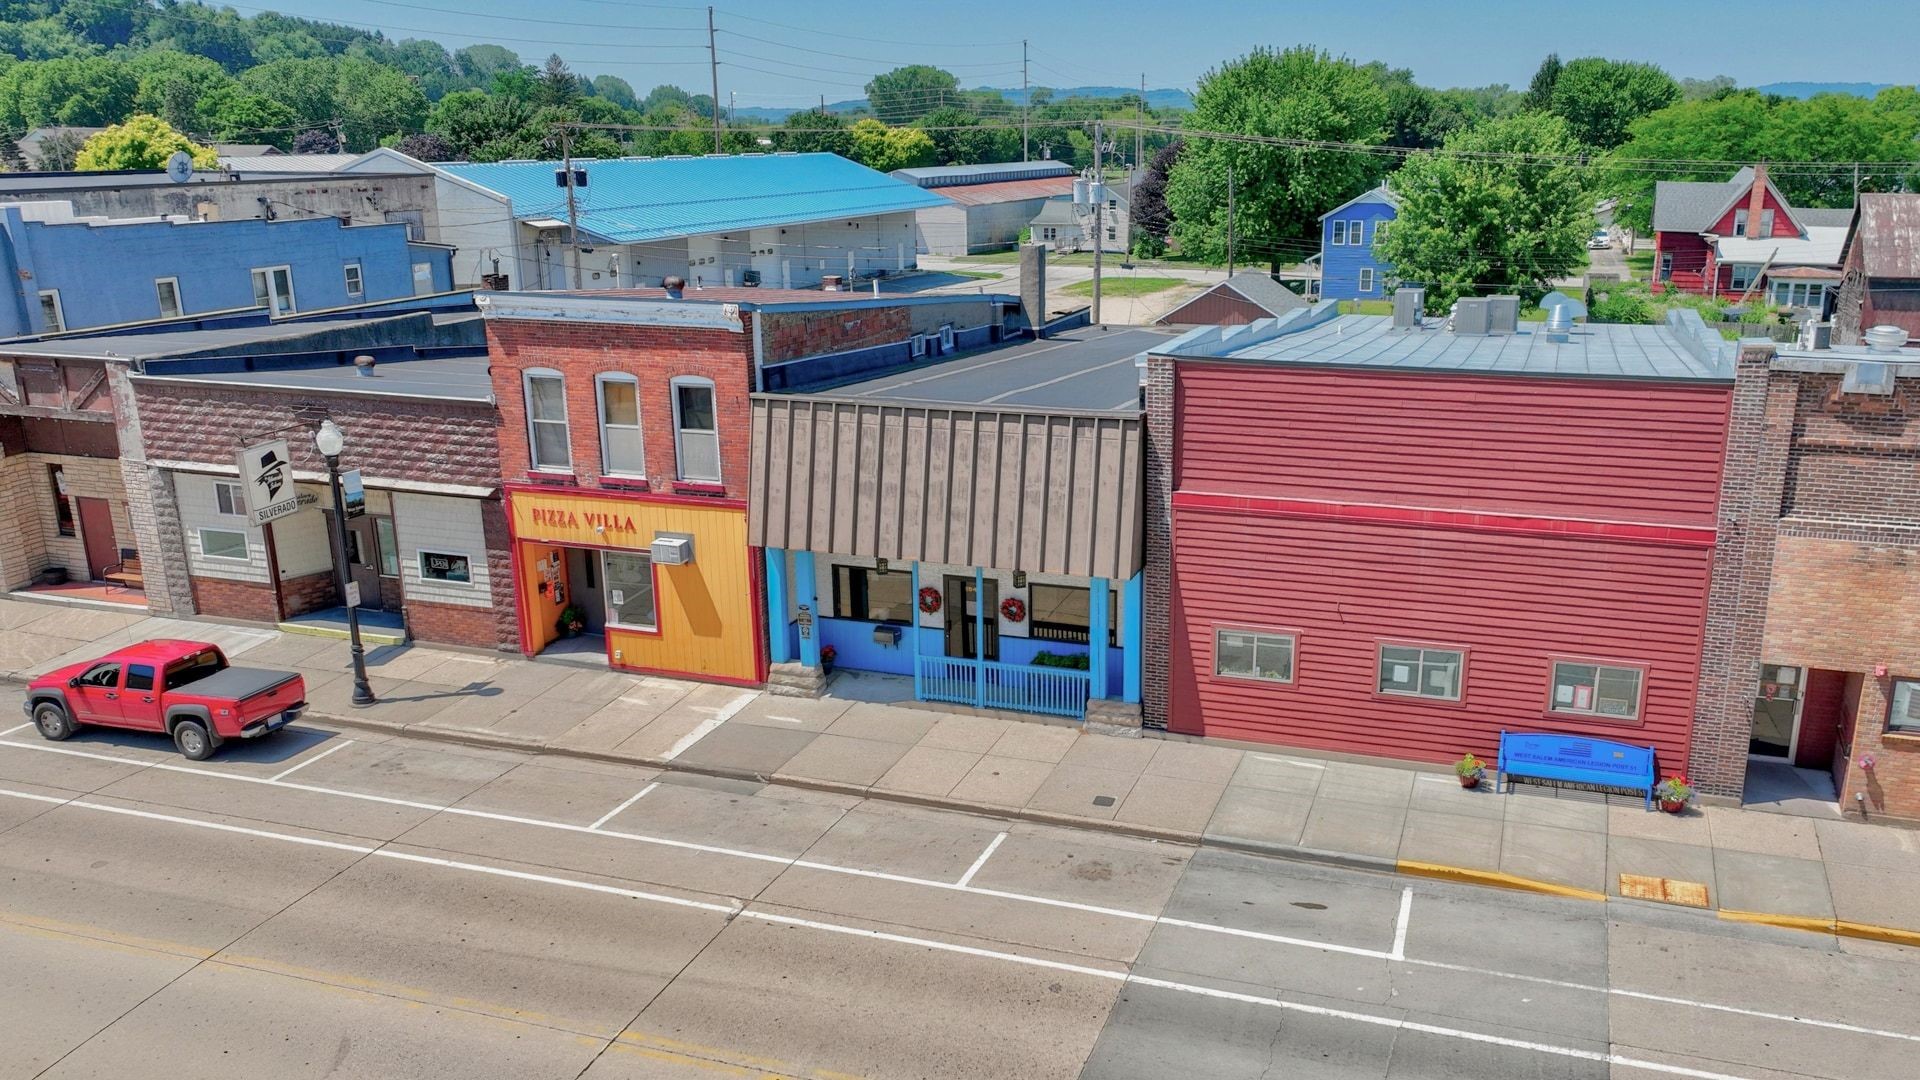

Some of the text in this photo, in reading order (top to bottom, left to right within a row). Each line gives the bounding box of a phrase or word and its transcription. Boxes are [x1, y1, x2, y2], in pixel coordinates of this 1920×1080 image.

[258, 500, 296, 521] SILVERADO
[532, 508, 635, 530] PIZZA VILLA
[1554, 756, 1587, 765] AMERICAN
[1587, 760, 1611, 768] LEGION
